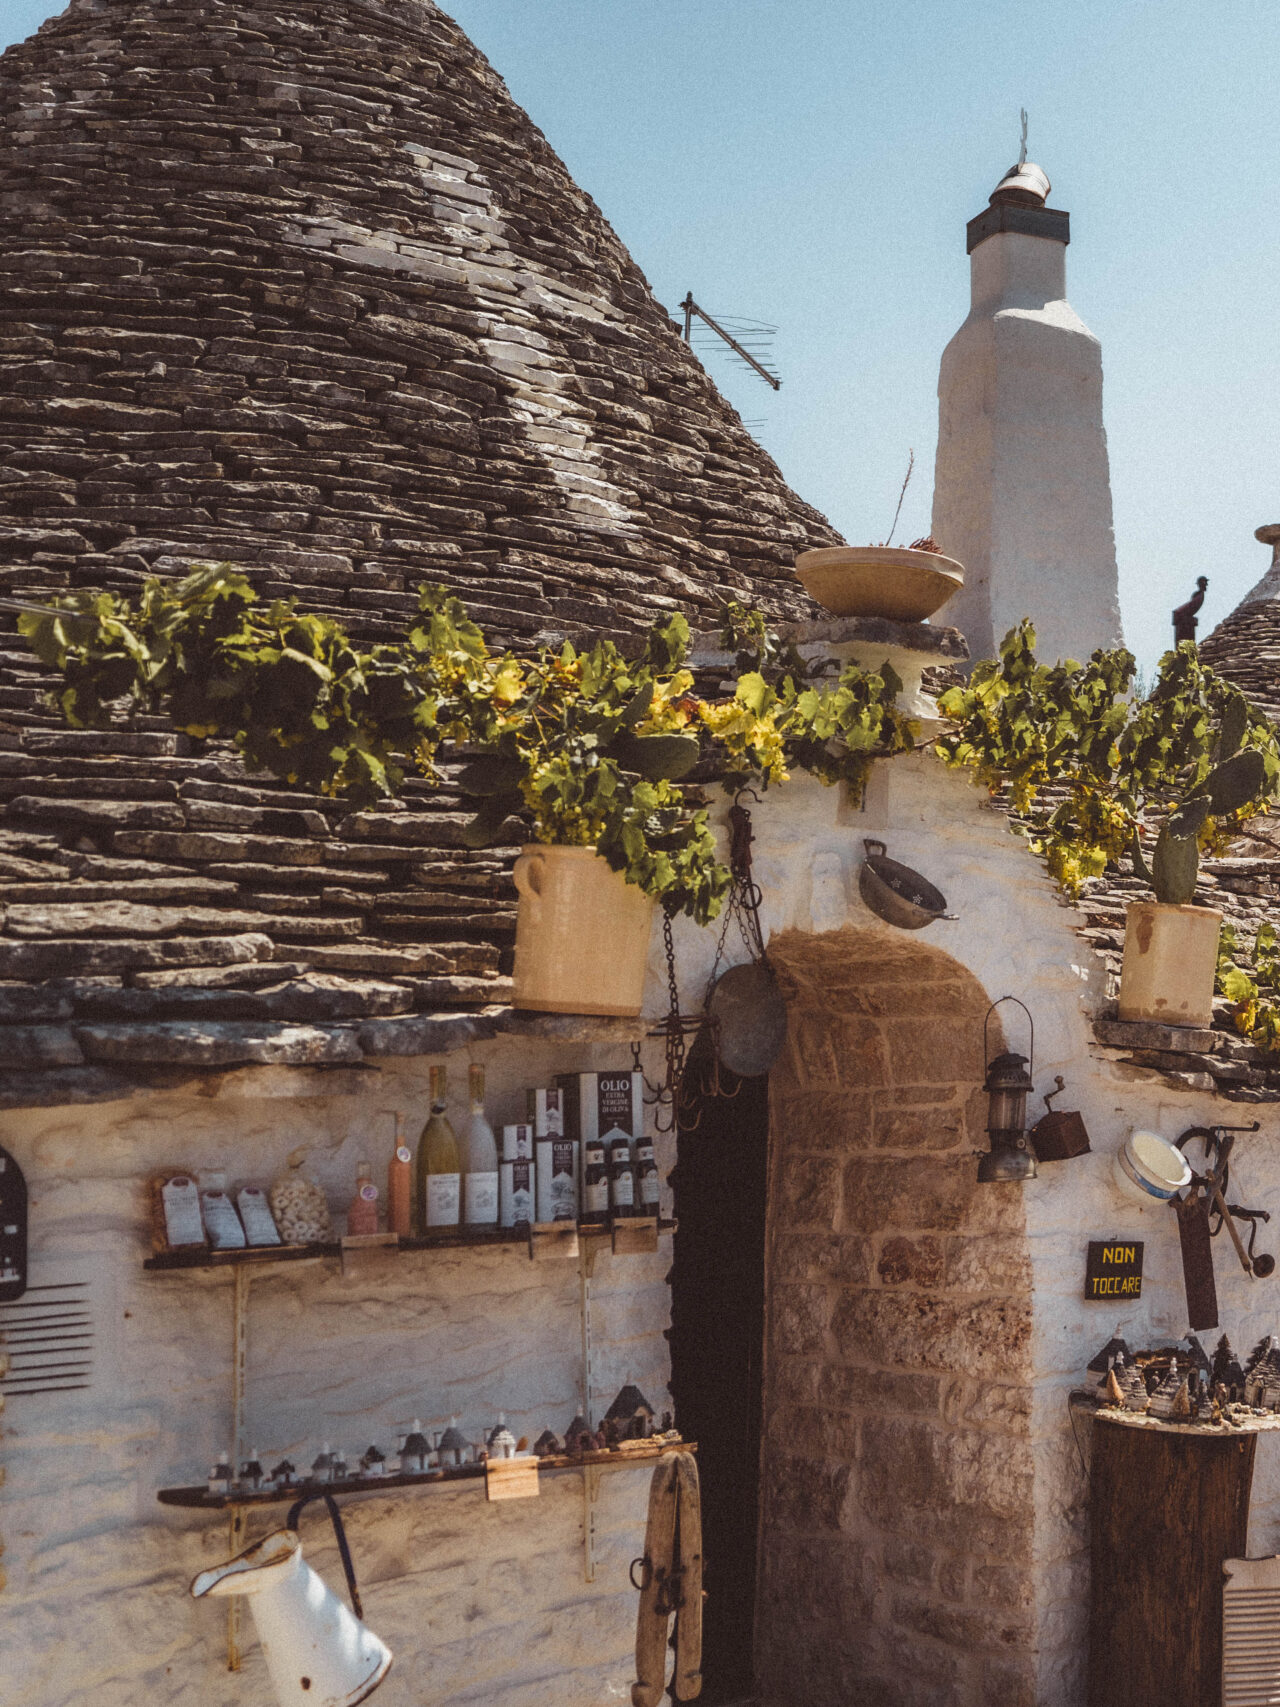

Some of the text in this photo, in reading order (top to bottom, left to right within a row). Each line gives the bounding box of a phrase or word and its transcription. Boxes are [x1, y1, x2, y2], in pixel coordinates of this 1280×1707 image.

[600, 1080, 630, 1091] OLIO
[553, 1143, 572, 1152] OLIO
[1102, 1247, 1136, 1264] NON
[1092, 1276, 1142, 1294] TOCCARE
